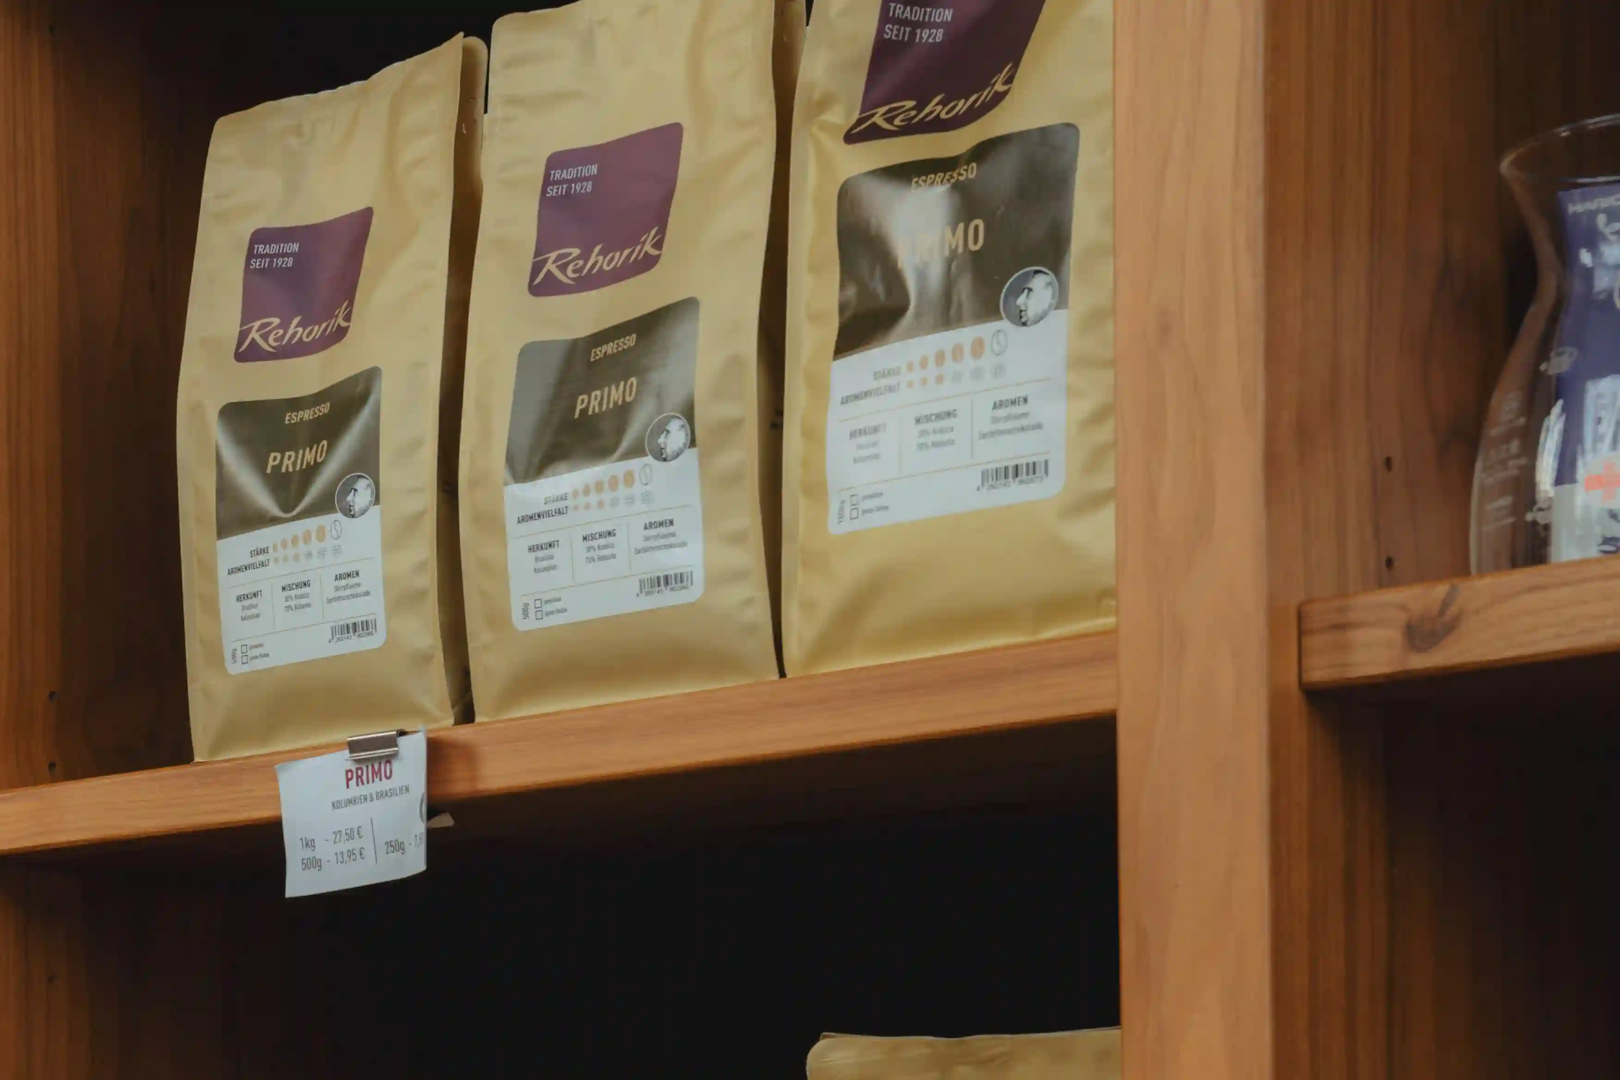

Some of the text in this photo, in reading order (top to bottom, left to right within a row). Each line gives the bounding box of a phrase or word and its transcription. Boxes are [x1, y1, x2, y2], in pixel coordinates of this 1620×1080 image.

[889, 3, 953, 22] TRADITION
[884, 24, 943, 42] SEIT 1928
[851, 62, 1014, 134] Rehorik
[549, 164, 598, 182] TRADITION
[911, 163, 977, 192] ESPRESSO
[546, 181, 593, 196] SEIT 1928
[253, 242, 299, 256] TRADITION
[532, 226, 664, 286] Rehorik
[250, 256, 294, 269] SEIT 1928
[239, 301, 351, 354] Rehorik
[590, 333, 637, 362] ESPRESSO
[574, 376, 638, 419] PRIMO
[992, 395, 1029, 411] AROMEN
[285, 402, 330, 424] ESPRESSO
[914, 409, 957, 426] MISCHUNG
[266, 440, 328, 474] PRIMO
[544, 492, 569, 505] STÄRKE
[517, 506, 569, 524] AROMENVIELFALT
[643, 519, 674, 531] AROMEN
[582, 529, 617, 543] MISCHUNG
[250, 546, 269, 558] STÄRKE
[527, 540, 560, 553] HERKUNFT
[227, 559, 270, 576] AROMENVIELFALT
[334, 570, 360, 582] AROMEN
[281, 580, 311, 592] MISCHUNG
[236, 590, 263, 603] HERKUNFT
[345, 759, 393, 789] PRIMO
[332, 794, 368, 810] KOLUMBIEN
[375, 785, 410, 801] BRASILIEN
[300, 837, 316, 852] 1kg
[333, 827, 355, 845] 27,50
[357, 826, 363, 838] €
[385, 840, 405, 855] 250g
[301, 856, 322, 871] 500g
[335, 850, 357, 865] 13,95
[359, 847, 365, 860] €
